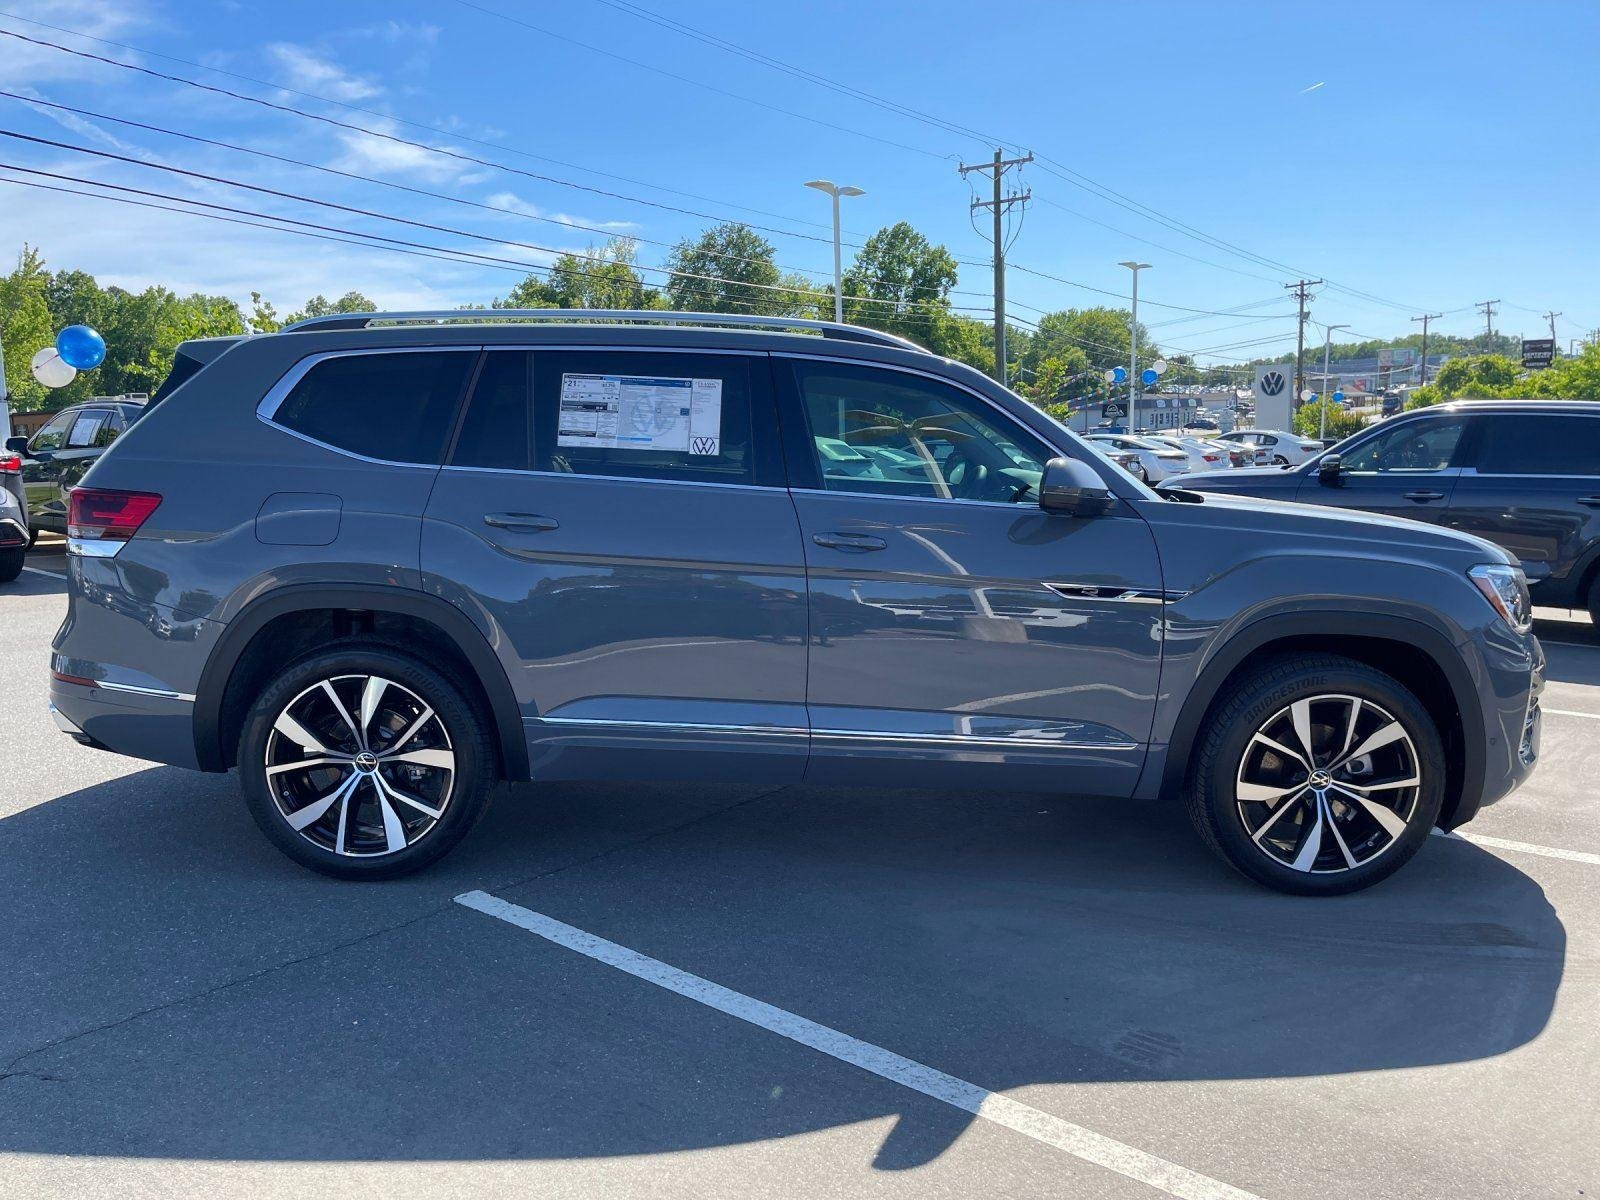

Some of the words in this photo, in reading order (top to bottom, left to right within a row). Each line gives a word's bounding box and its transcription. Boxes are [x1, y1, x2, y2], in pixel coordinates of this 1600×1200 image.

[1261, 371, 1285, 396] VW
[693, 437, 716, 455] VW
[1244, 675, 1329, 725] BRIDGESTONE
